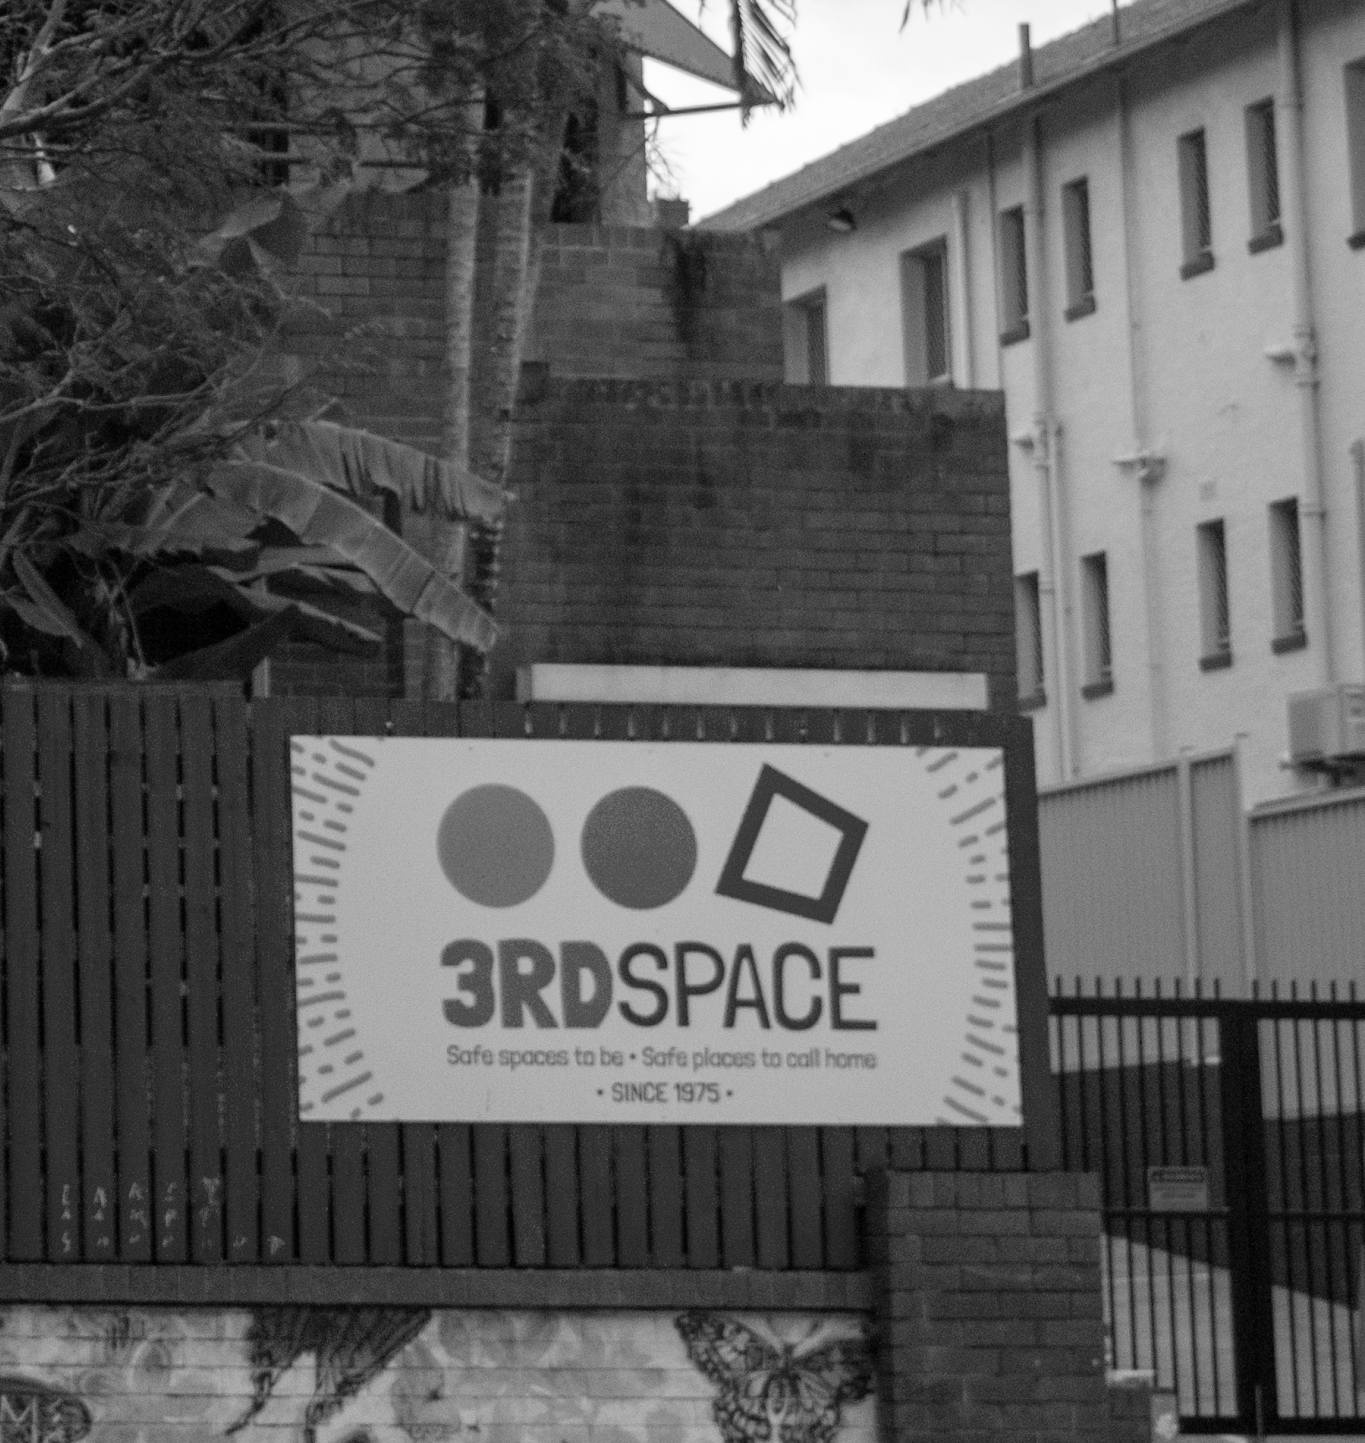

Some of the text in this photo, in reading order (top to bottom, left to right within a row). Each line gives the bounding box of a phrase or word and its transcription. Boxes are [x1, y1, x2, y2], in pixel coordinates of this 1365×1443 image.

[439, 936, 880, 1033] 3RDSPACE
[445, 1043, 878, 1071] Safe spaces to be Safe places to call home
[611, 1081, 722, 1105] SINCE 1975
